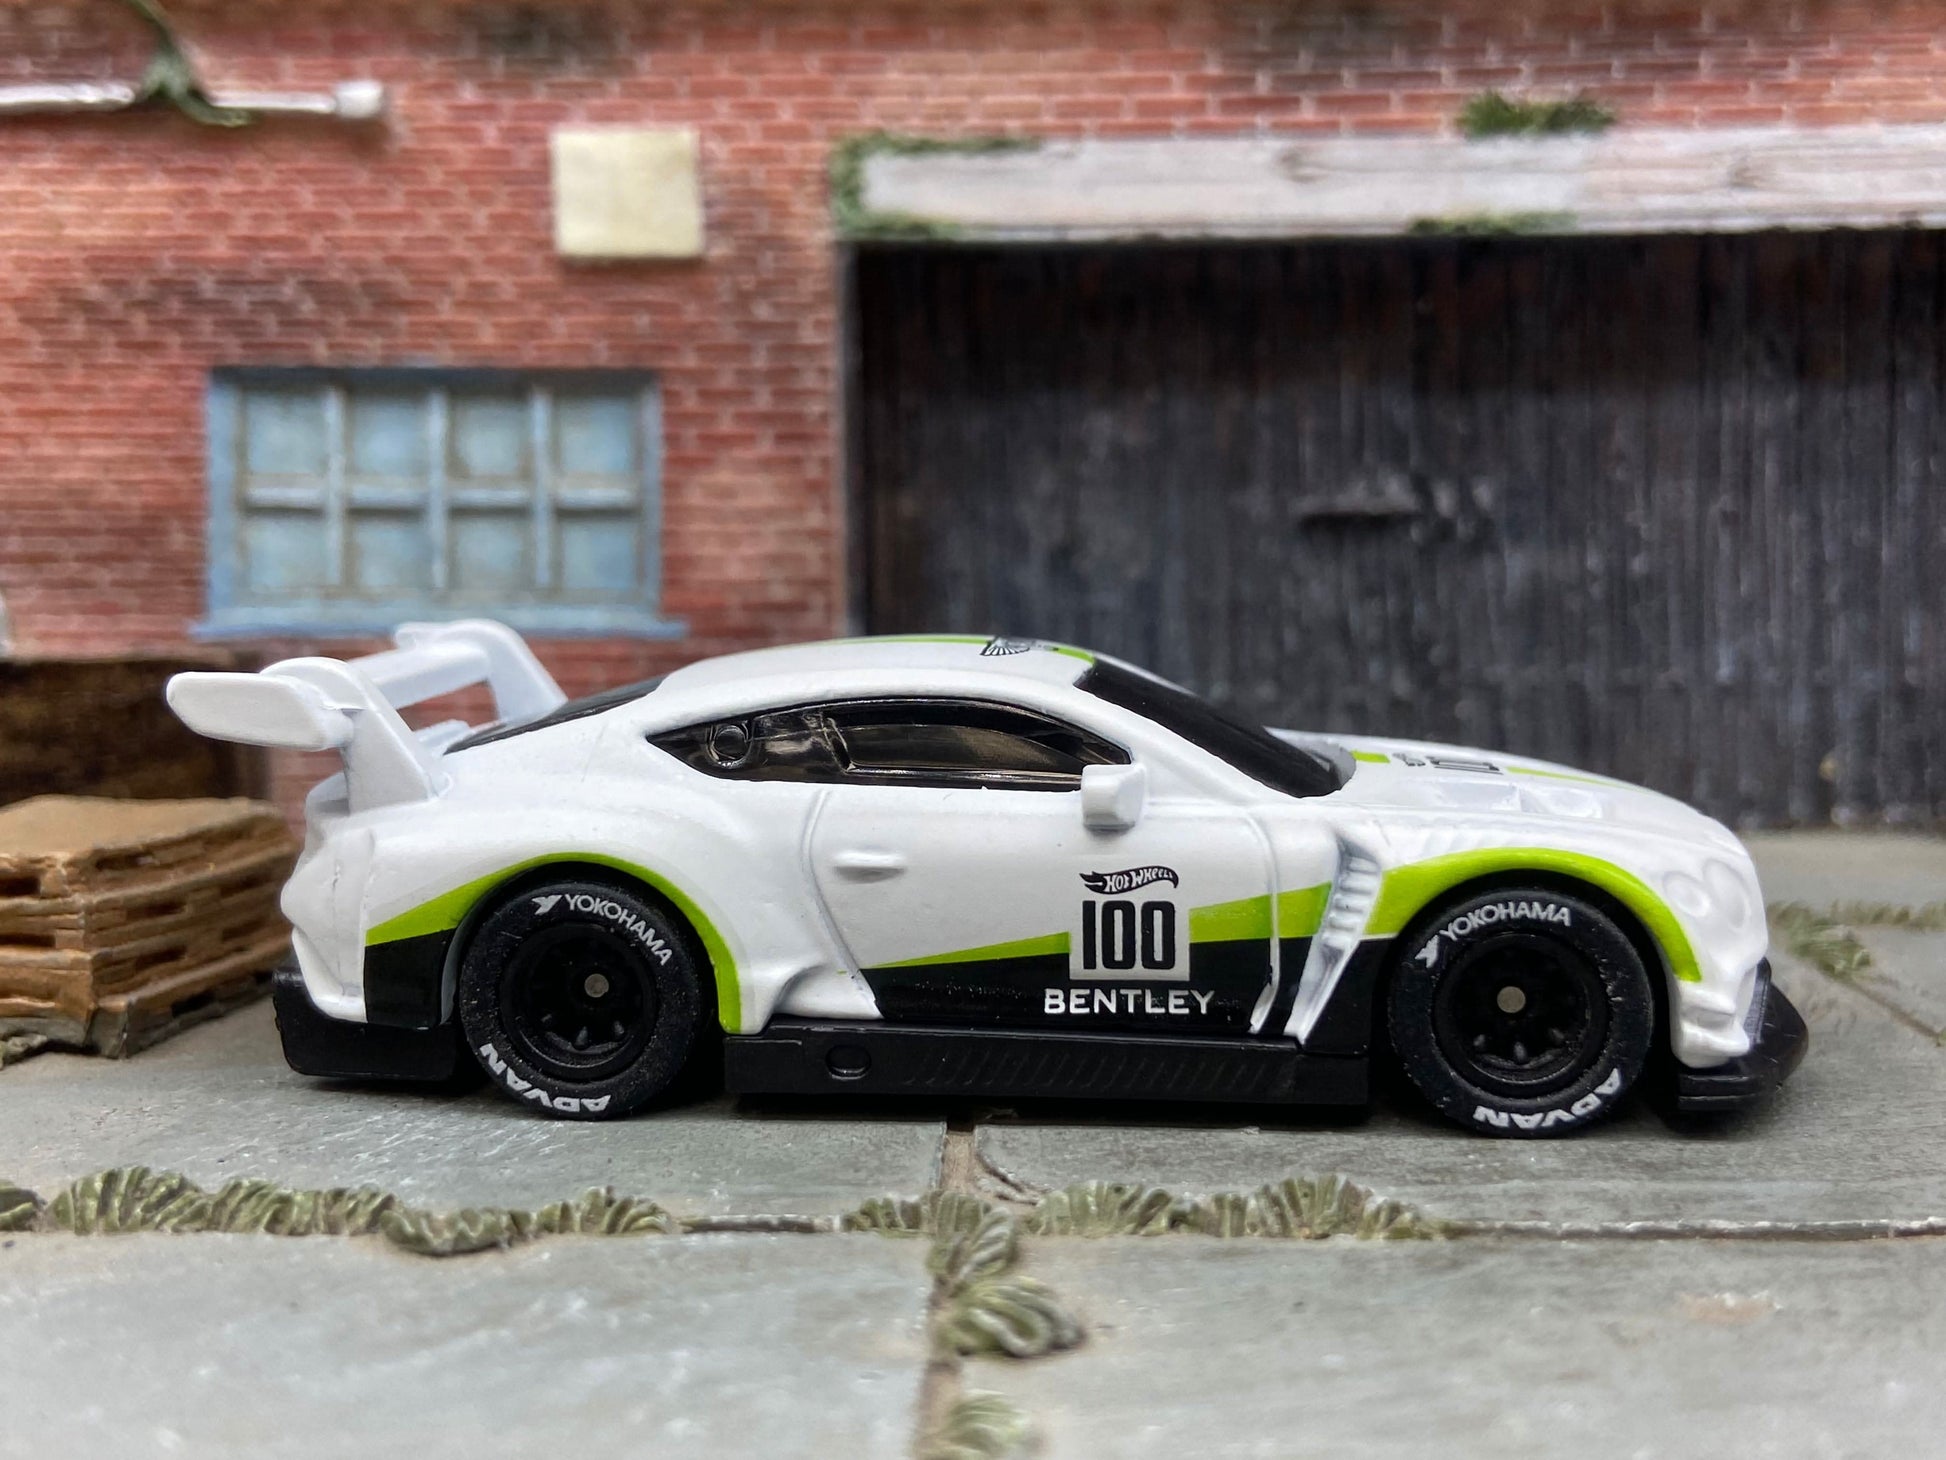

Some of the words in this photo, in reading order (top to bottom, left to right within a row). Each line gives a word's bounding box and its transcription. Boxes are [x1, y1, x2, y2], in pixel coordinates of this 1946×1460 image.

[565, 893, 673, 966] YOKOHAMA
[1082, 900, 1176, 970] 100
[1439, 901, 1572, 942] YOKOHAMA
[1043, 987, 1215, 1015] BENTLEY
[479, 1042, 612, 1113] ADVAN
[1472, 1067, 1622, 1130] ADVAN
